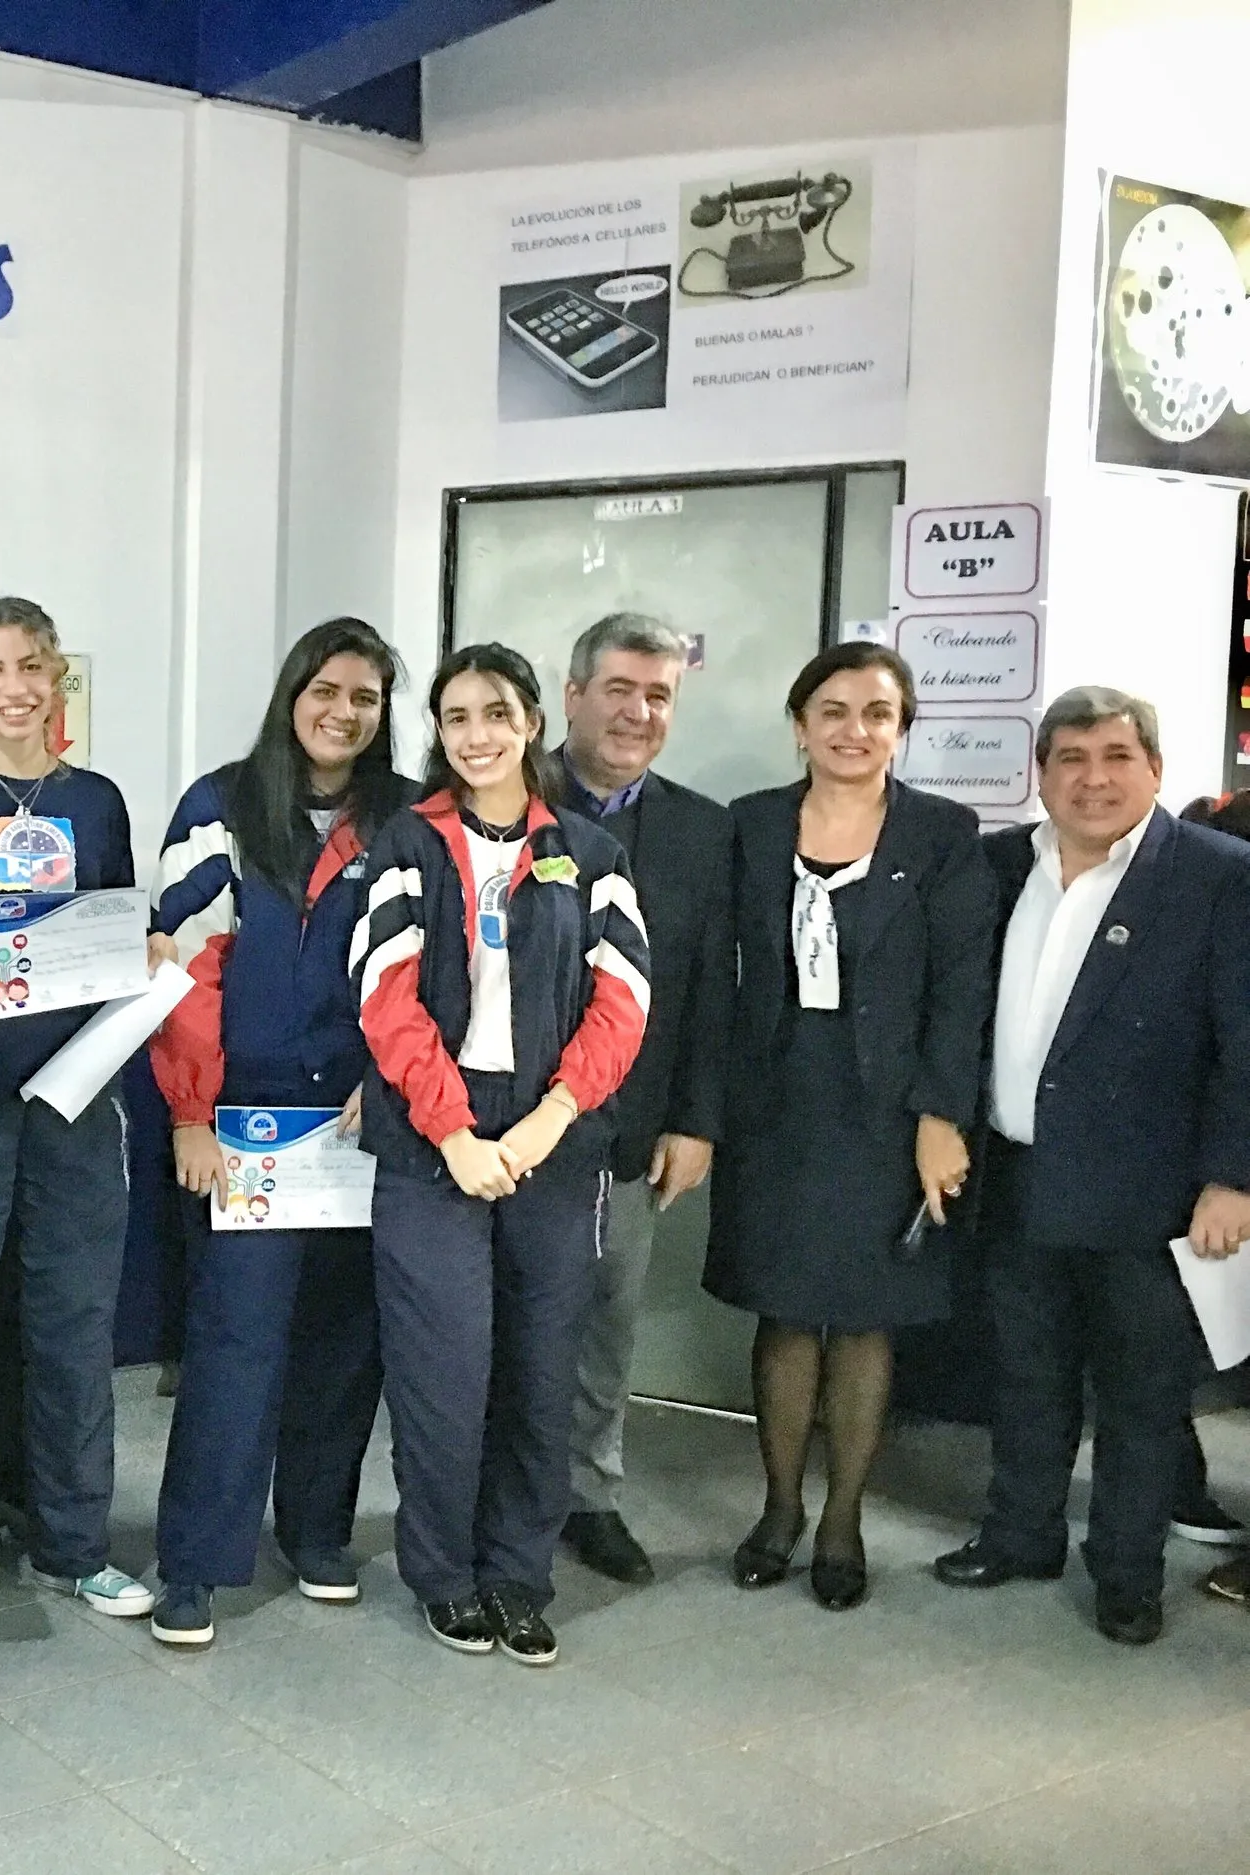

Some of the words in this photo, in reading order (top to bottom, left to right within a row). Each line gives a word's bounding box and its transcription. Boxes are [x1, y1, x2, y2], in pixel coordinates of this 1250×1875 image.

[511, 215, 526, 227] LA
[528, 204, 595, 226] EVOLUCIÓN
[598, 202, 615, 216] DE
[617, 198, 642, 213] LOS
[595, 222, 667, 242] CELULARES
[695, 331, 745, 348] BUENAS
[748, 330, 758, 342] O
[760, 325, 803, 342] MALAS
[692, 369, 771, 387] PERJUDICAN
[777, 368, 787, 380] O
[790, 359, 875, 379] BENEFICIAN?
[924, 519, 1015, 543] AULA
